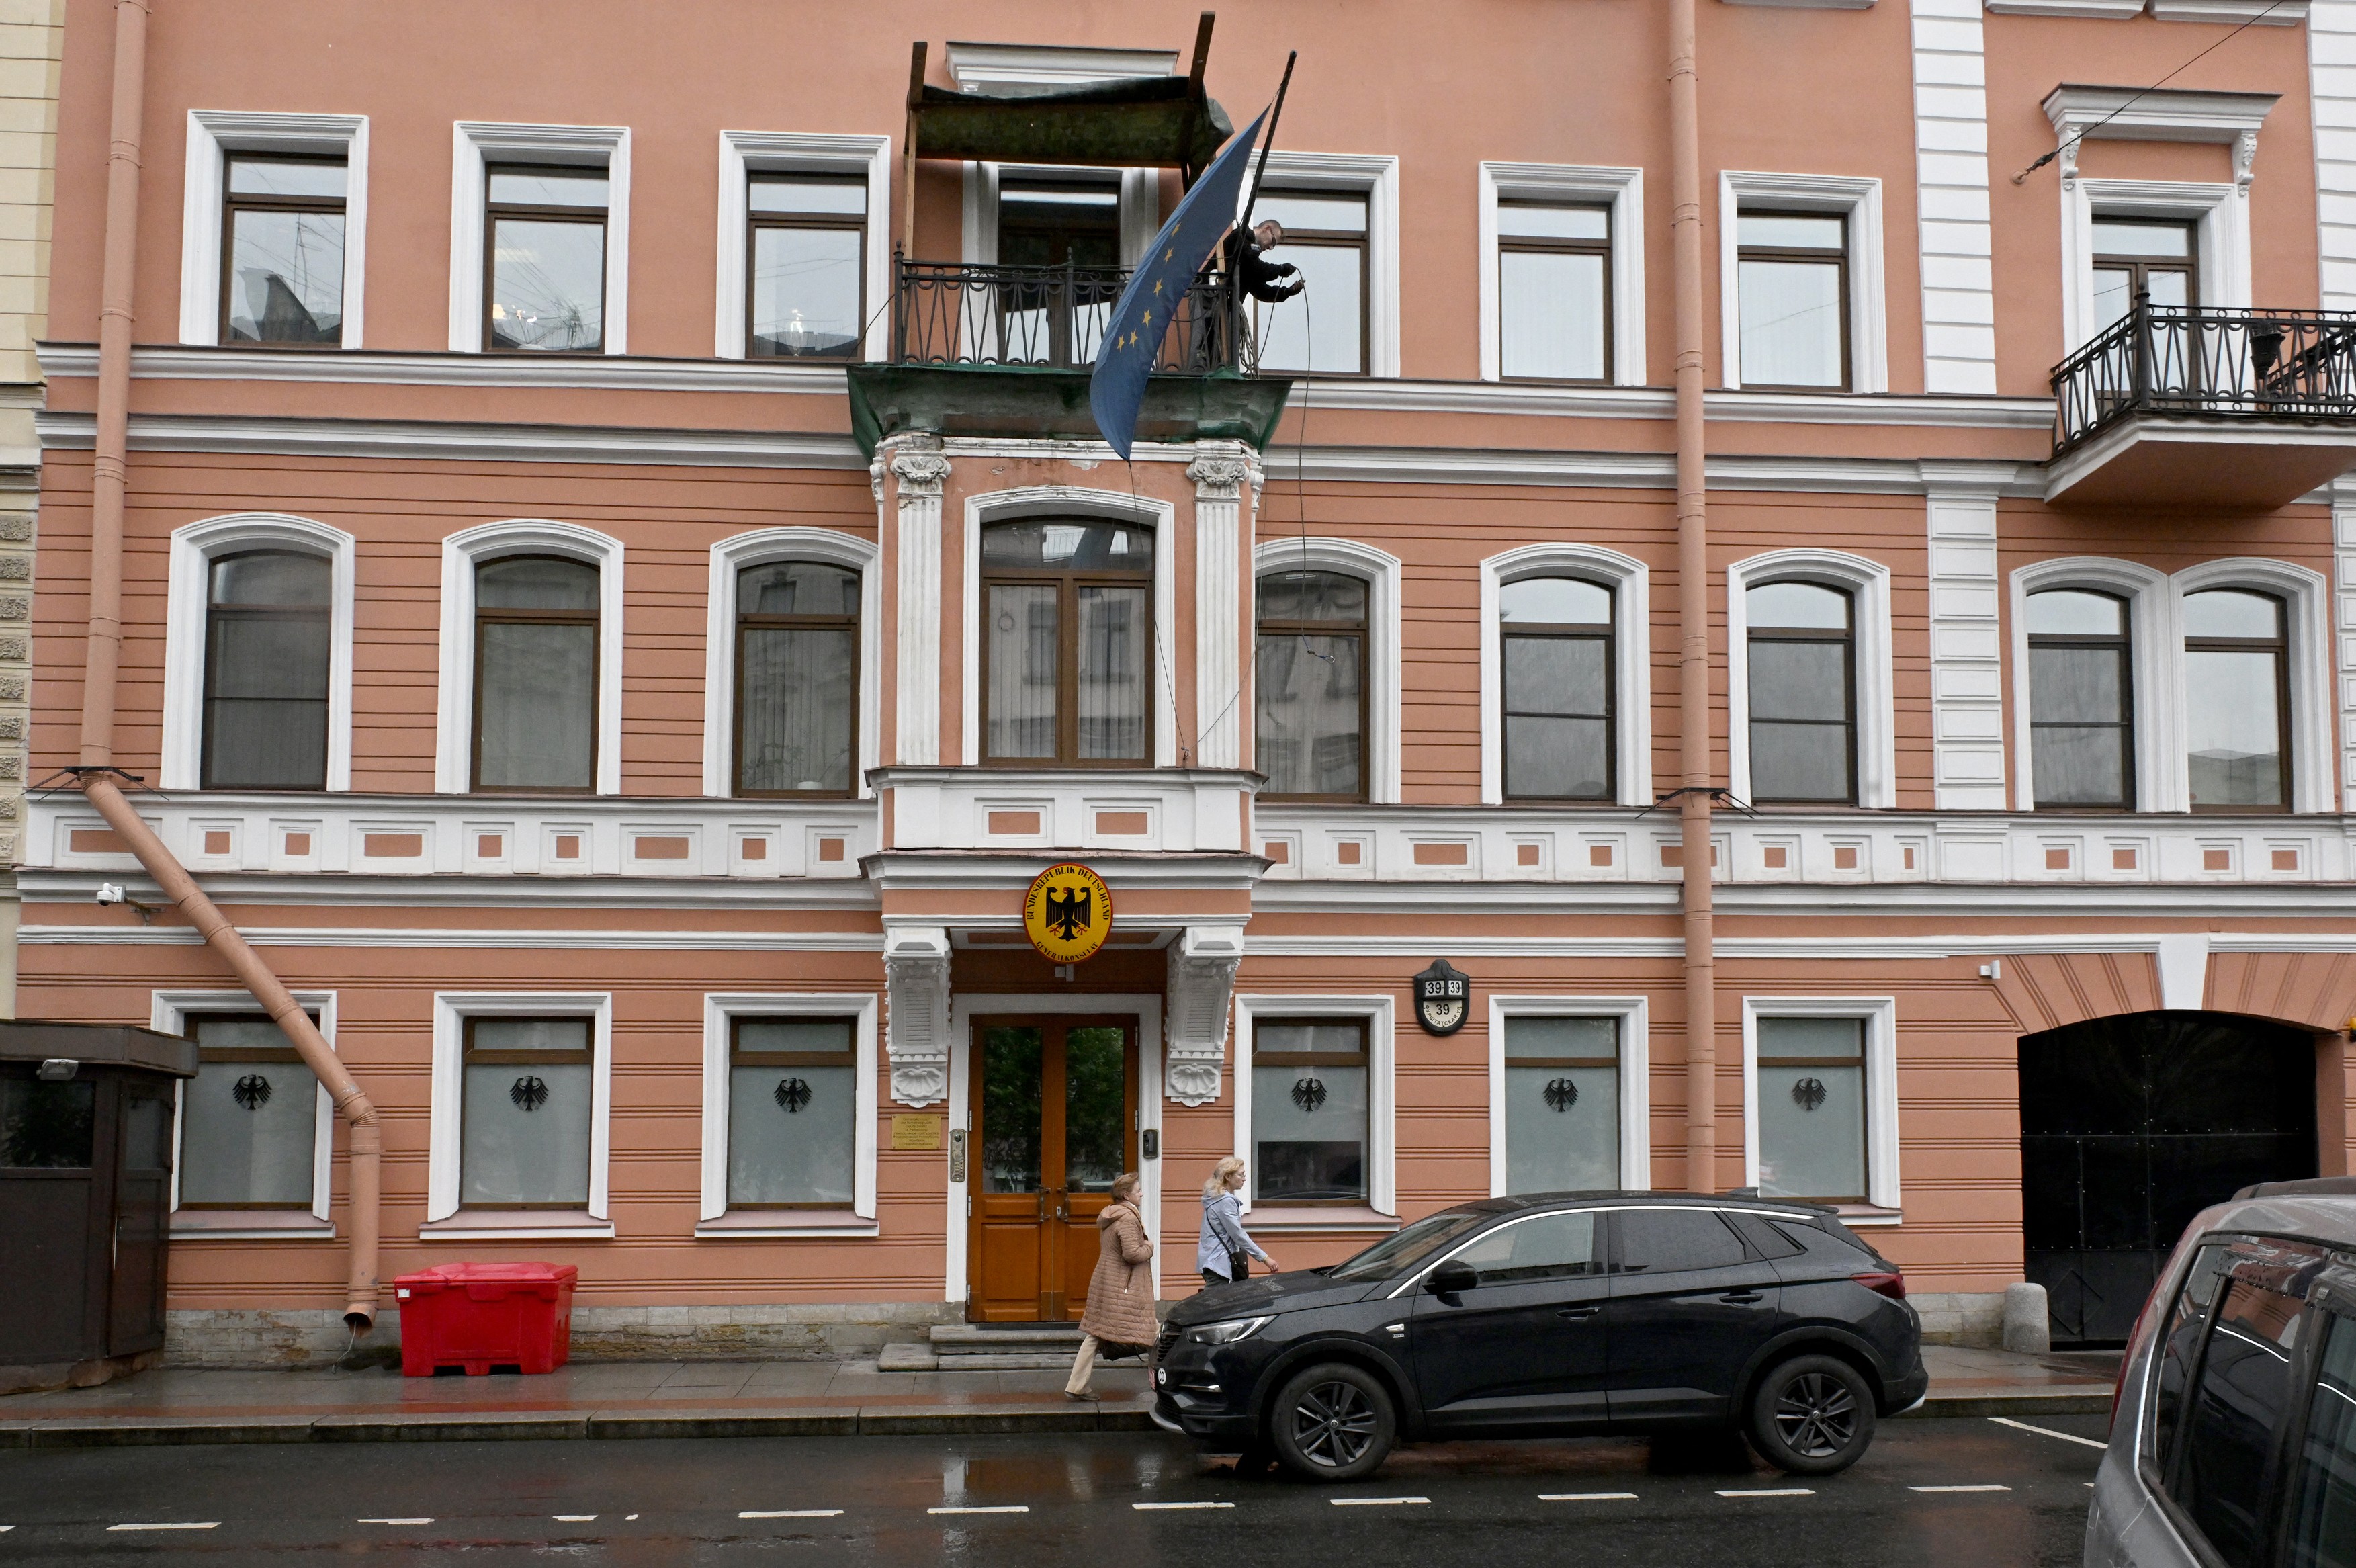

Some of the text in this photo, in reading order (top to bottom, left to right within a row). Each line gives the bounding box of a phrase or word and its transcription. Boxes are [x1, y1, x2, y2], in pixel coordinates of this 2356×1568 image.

[1027, 866, 1110, 920] BUNDESREPUBLIK DEUTSCHLAND
[1036, 941, 1098, 961] GENERALKONSULAT
[1428, 982, 1442, 994] 39
[1450, 982, 1460, 994] 39
[1425, 1004, 1458, 1026] ФУРШТАТСКАЯ
[1436, 1004, 1450, 1016] 39
